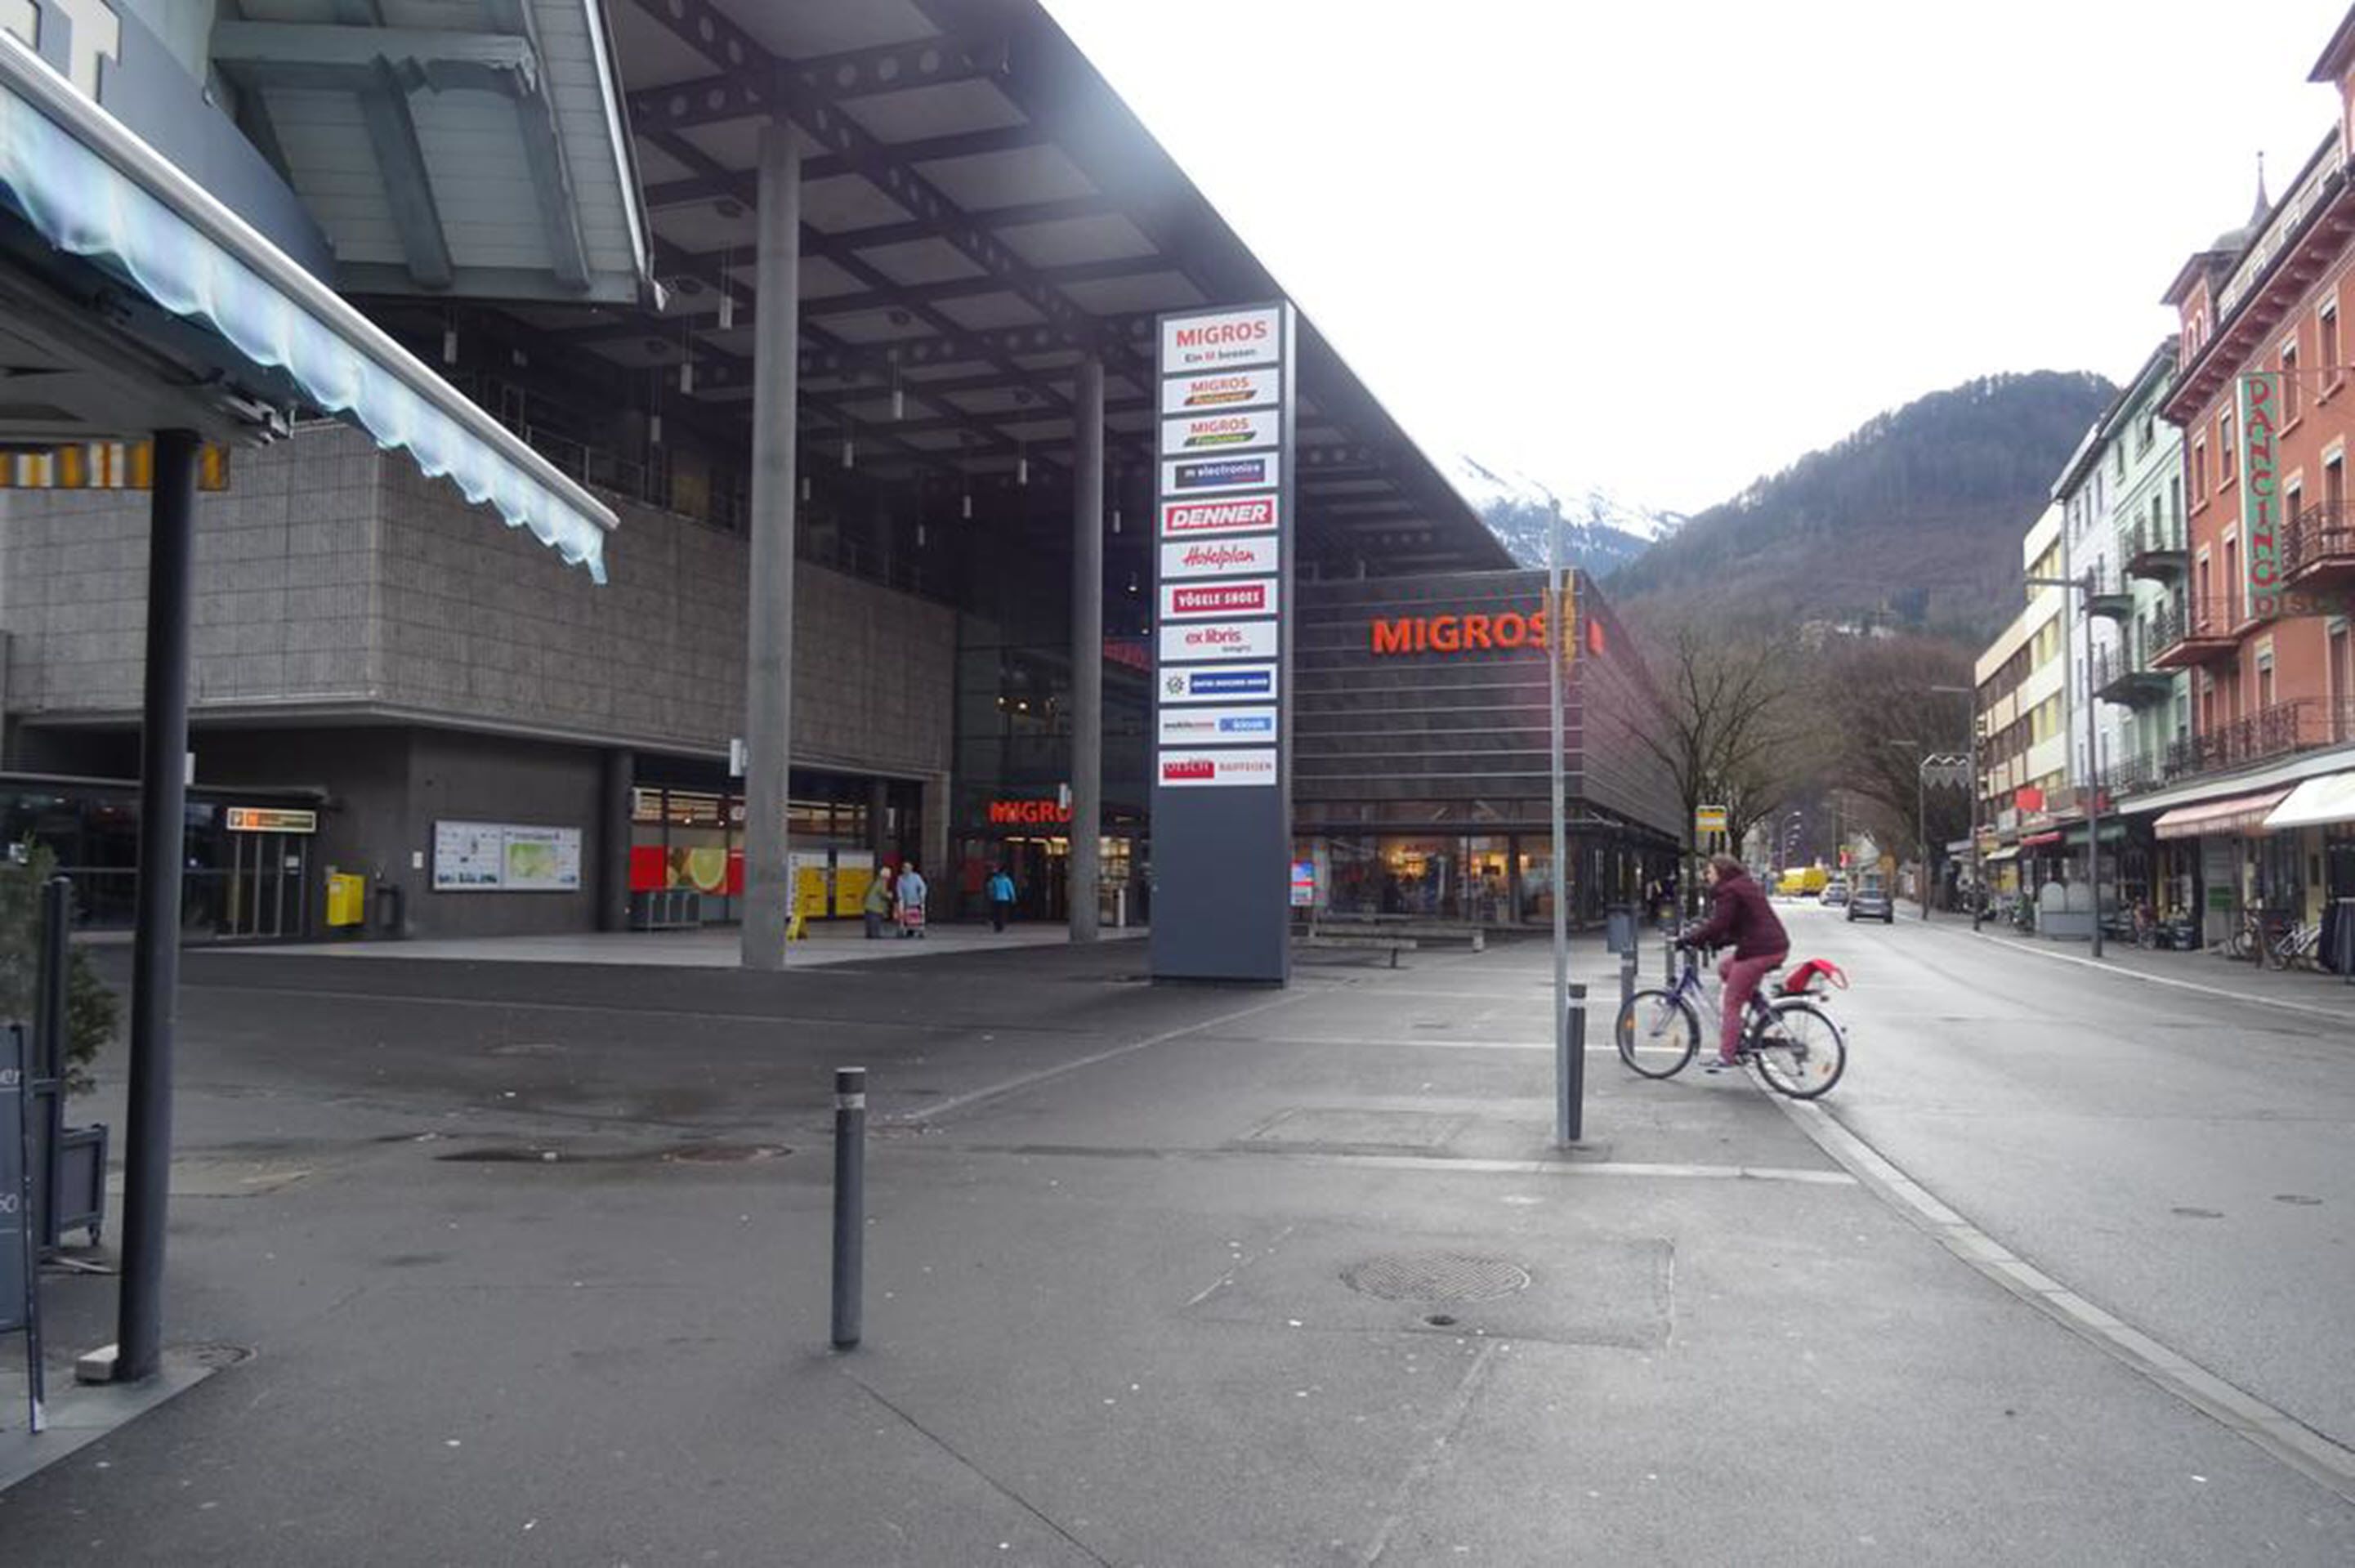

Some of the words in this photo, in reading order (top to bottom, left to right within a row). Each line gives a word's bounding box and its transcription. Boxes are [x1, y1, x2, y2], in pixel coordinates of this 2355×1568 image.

[1177, 321, 1268, 347] MIGROS
[1191, 377, 1250, 392] MIGROS
[1190, 418, 1249, 434] MIGROS
[1171, 504, 1267, 529] DENNER
[1182, 544, 1255, 570] Hotelplan
[1186, 634, 1202, 646] ex
[1204, 627, 1241, 644] libris
